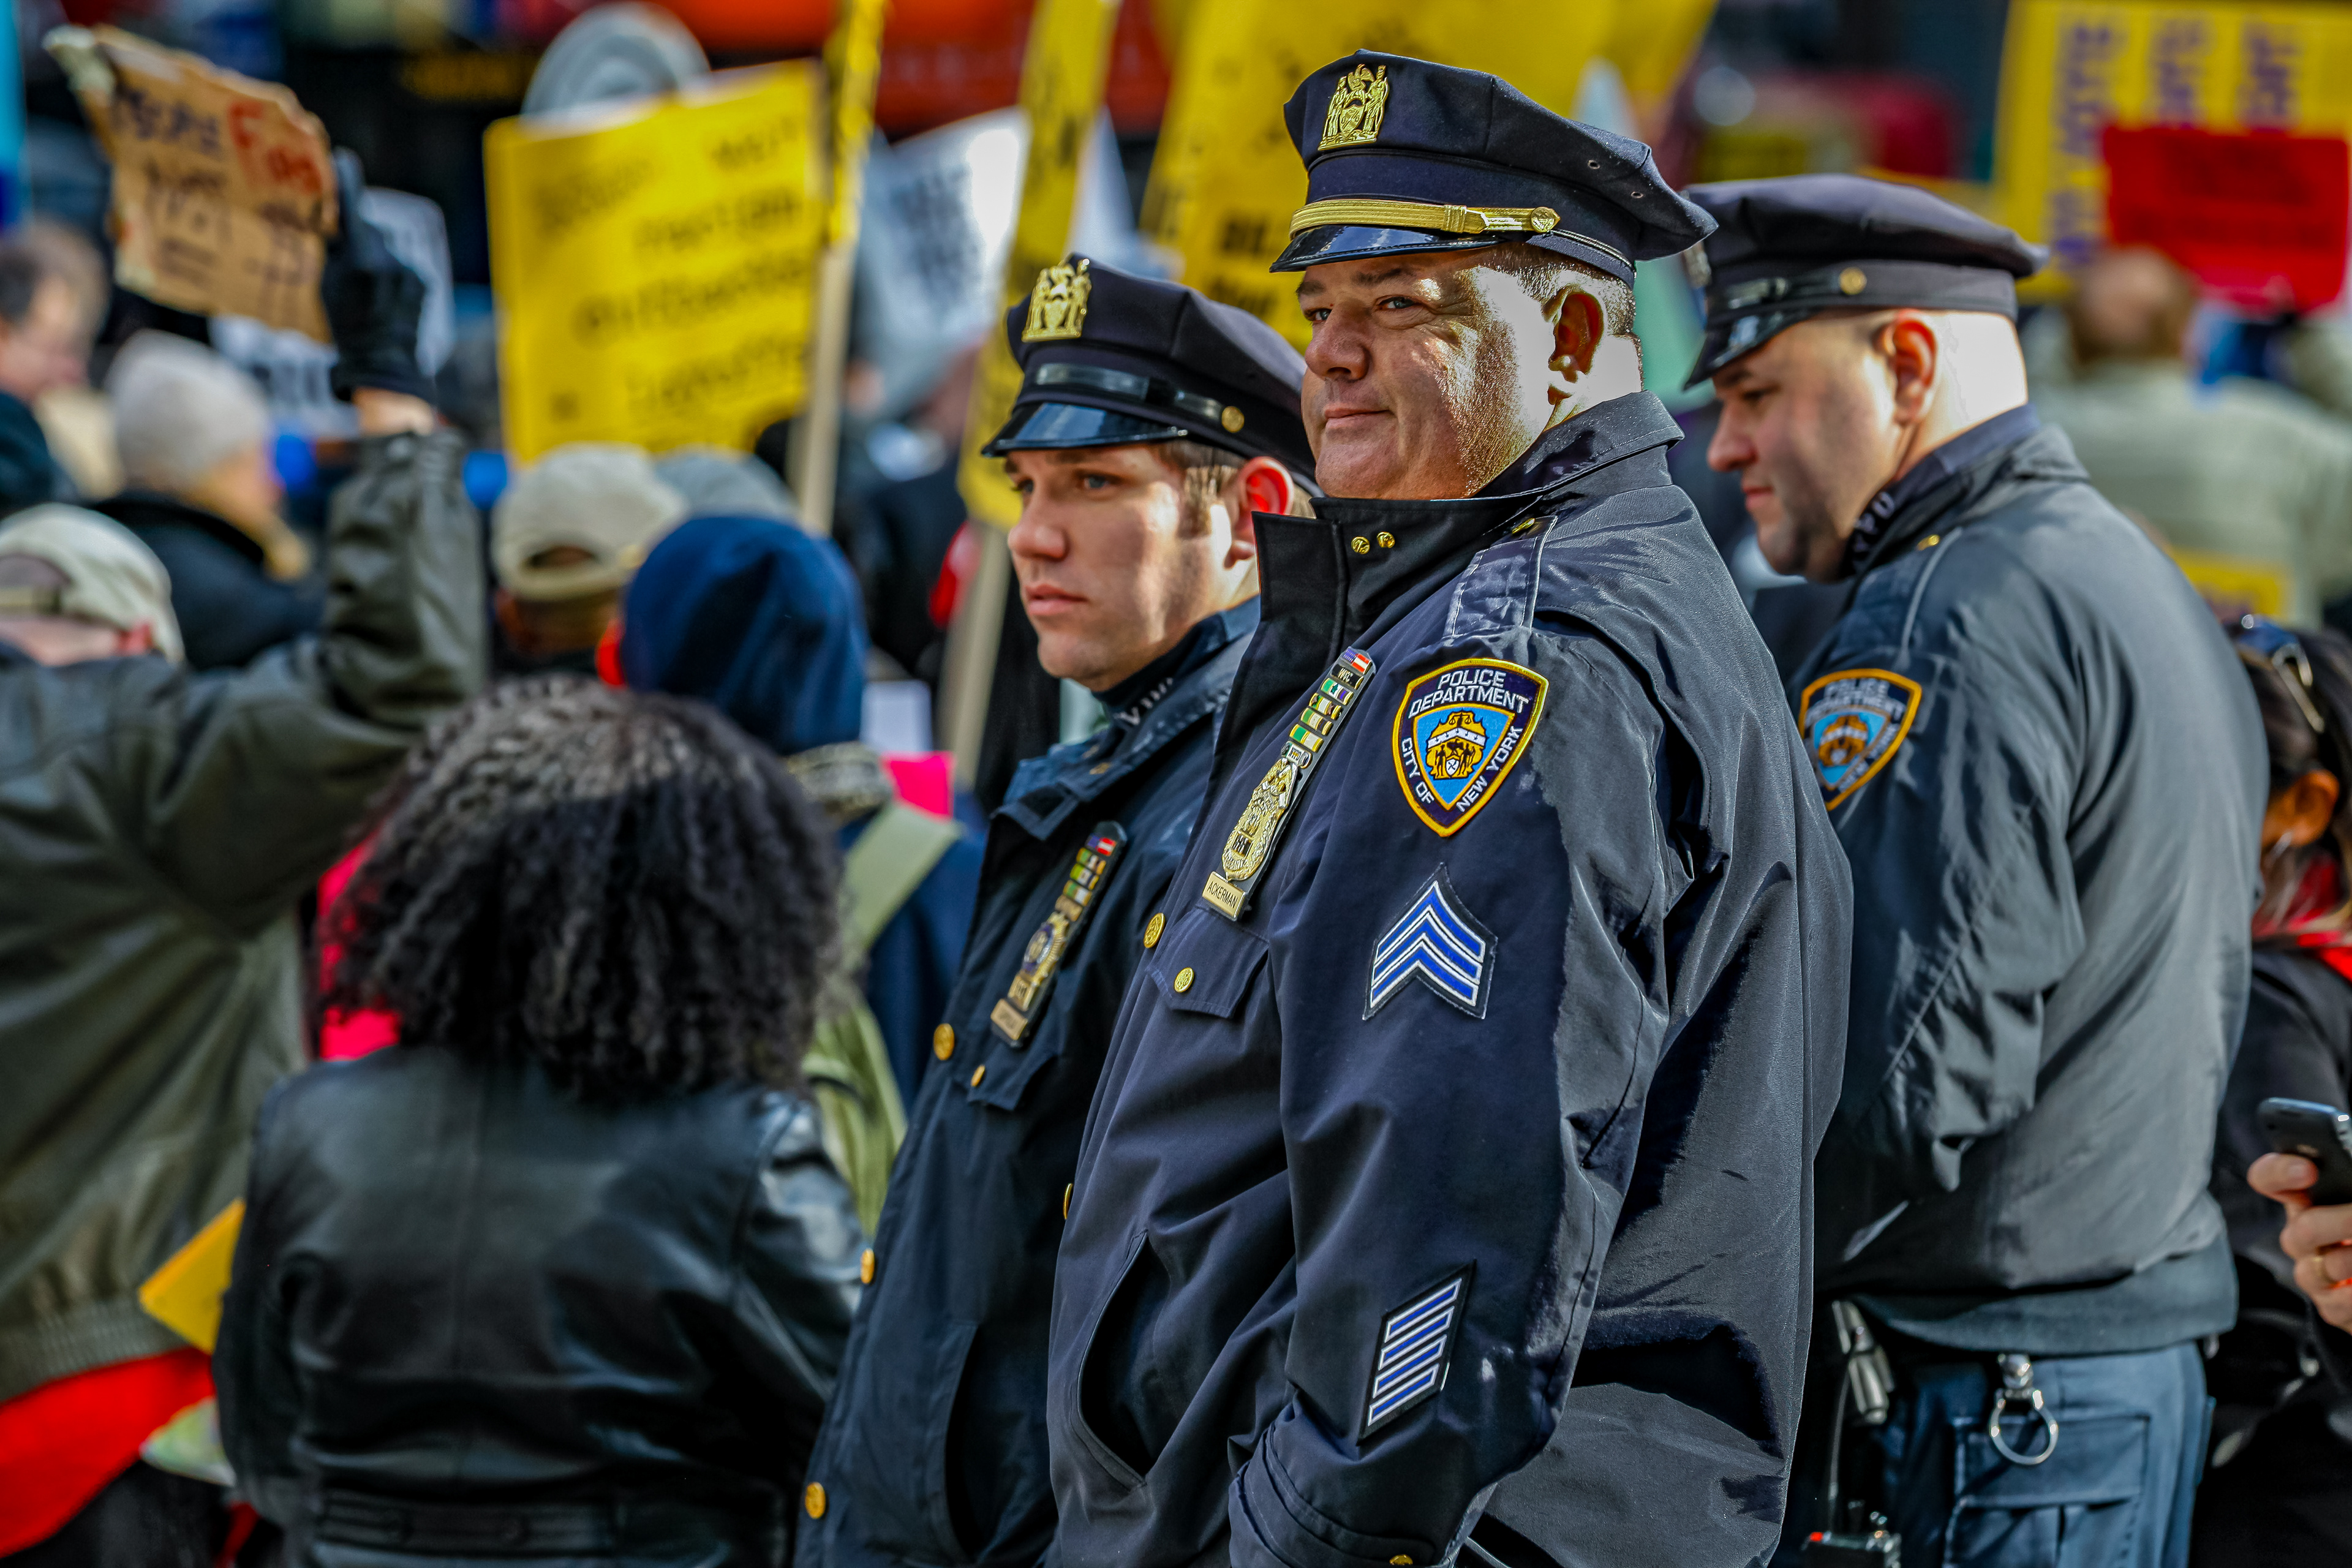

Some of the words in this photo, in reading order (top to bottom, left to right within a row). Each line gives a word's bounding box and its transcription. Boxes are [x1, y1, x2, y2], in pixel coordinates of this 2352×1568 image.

[1438, 668, 1507, 690] POLICE
[1408, 685, 1529, 719] DEPARTMENT
[1401, 737, 1421, 778] CITY
[1415, 781, 1435, 804] OF
[1456, 775, 1488, 812] NEW
[1486, 725, 1523, 771] YORK
[1207, 881, 1238, 909] ACKERMAN
